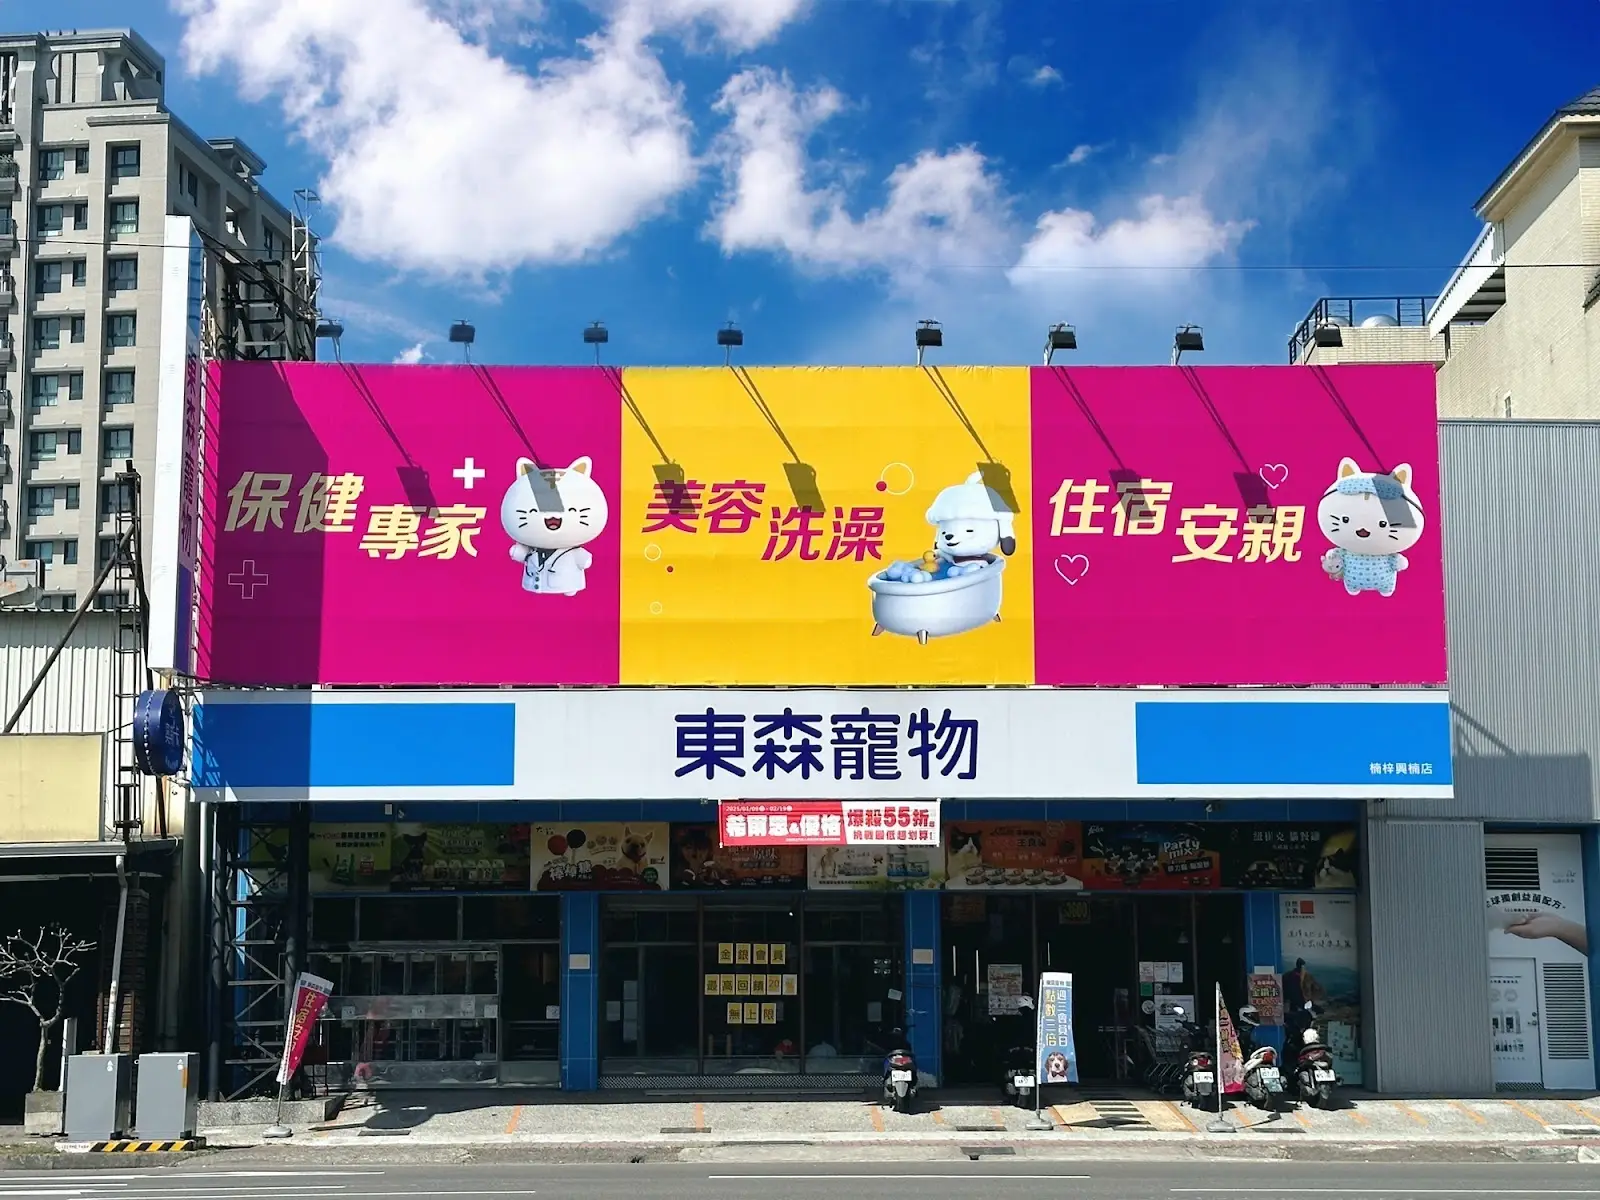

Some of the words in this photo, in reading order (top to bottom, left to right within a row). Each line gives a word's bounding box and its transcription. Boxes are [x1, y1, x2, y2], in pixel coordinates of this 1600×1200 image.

[674, 707, 978, 780] 東森寵物
[1369, 762, 1433, 774] 楠梓興楠店
[1163, 838, 1201, 853] Party
[292, 991, 317, 1052] 住宿安
[729, 1008, 775, 1021] 無上限
